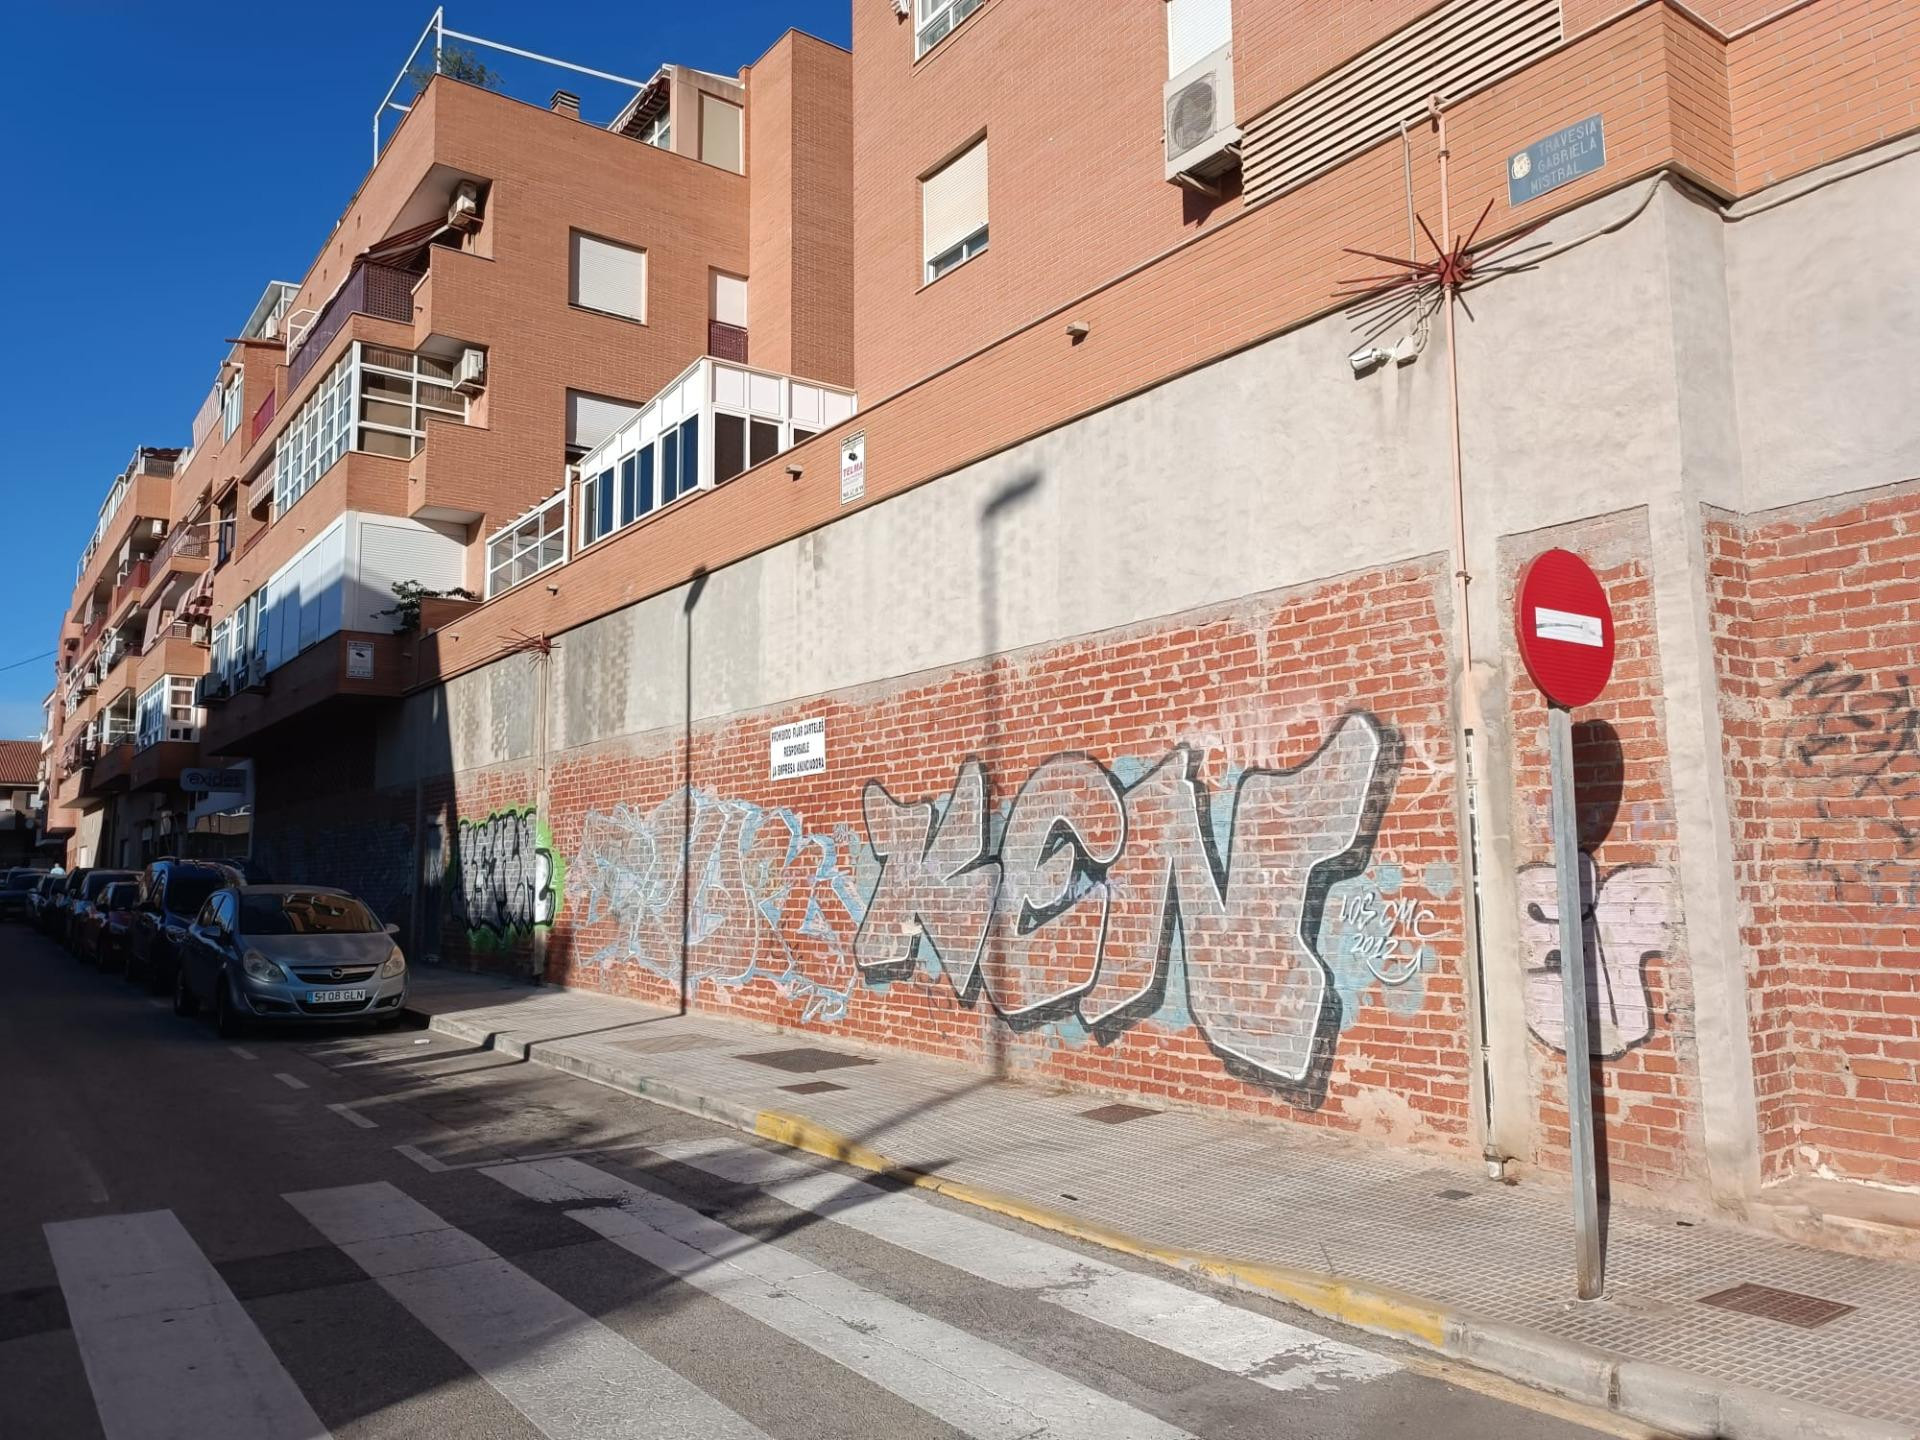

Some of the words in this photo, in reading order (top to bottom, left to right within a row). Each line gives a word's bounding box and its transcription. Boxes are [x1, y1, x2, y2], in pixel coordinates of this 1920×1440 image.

[1538, 120, 1597, 157] TRAVESIA
[1538, 137, 1597, 173] GABRIELA
[1530, 161, 1582, 194] MISTRAL
[843, 461, 863, 477] TELMA
[772, 728, 791, 742] PROHIBIDO
[793, 725, 803, 738] FIJAR
[804, 721, 824, 736] CARTELES
[778, 762, 796, 776] EMPRESA
[797, 757, 824, 772] ANUNCIADORA
[1339, 892, 1378, 931] LOS
[1350, 933, 1399, 960] 2012
[315, 991, 341, 1002] 5108
[344, 990, 364, 1001] GLN
